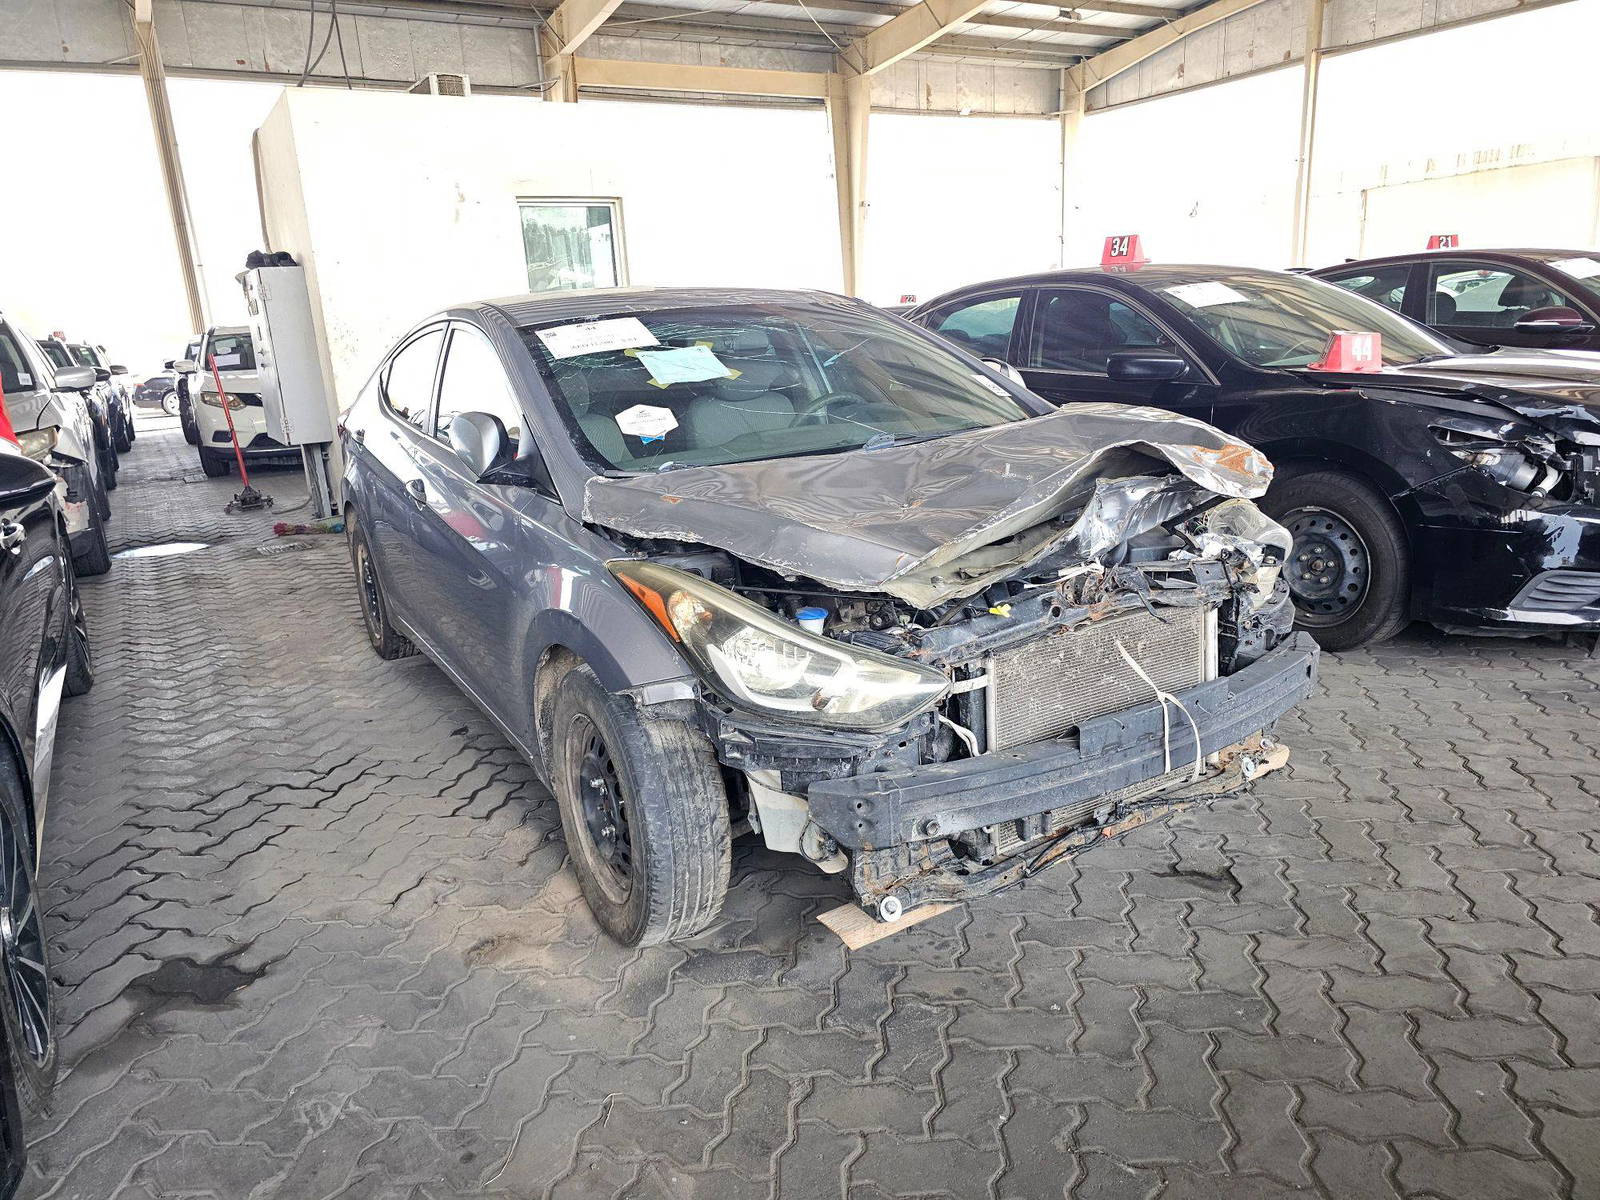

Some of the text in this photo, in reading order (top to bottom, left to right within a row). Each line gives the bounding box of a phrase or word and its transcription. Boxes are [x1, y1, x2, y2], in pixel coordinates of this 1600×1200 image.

[1111, 236, 1129, 257] 34
[1440, 235, 1452, 248] 21
[1352, 335, 1373, 361] 44
